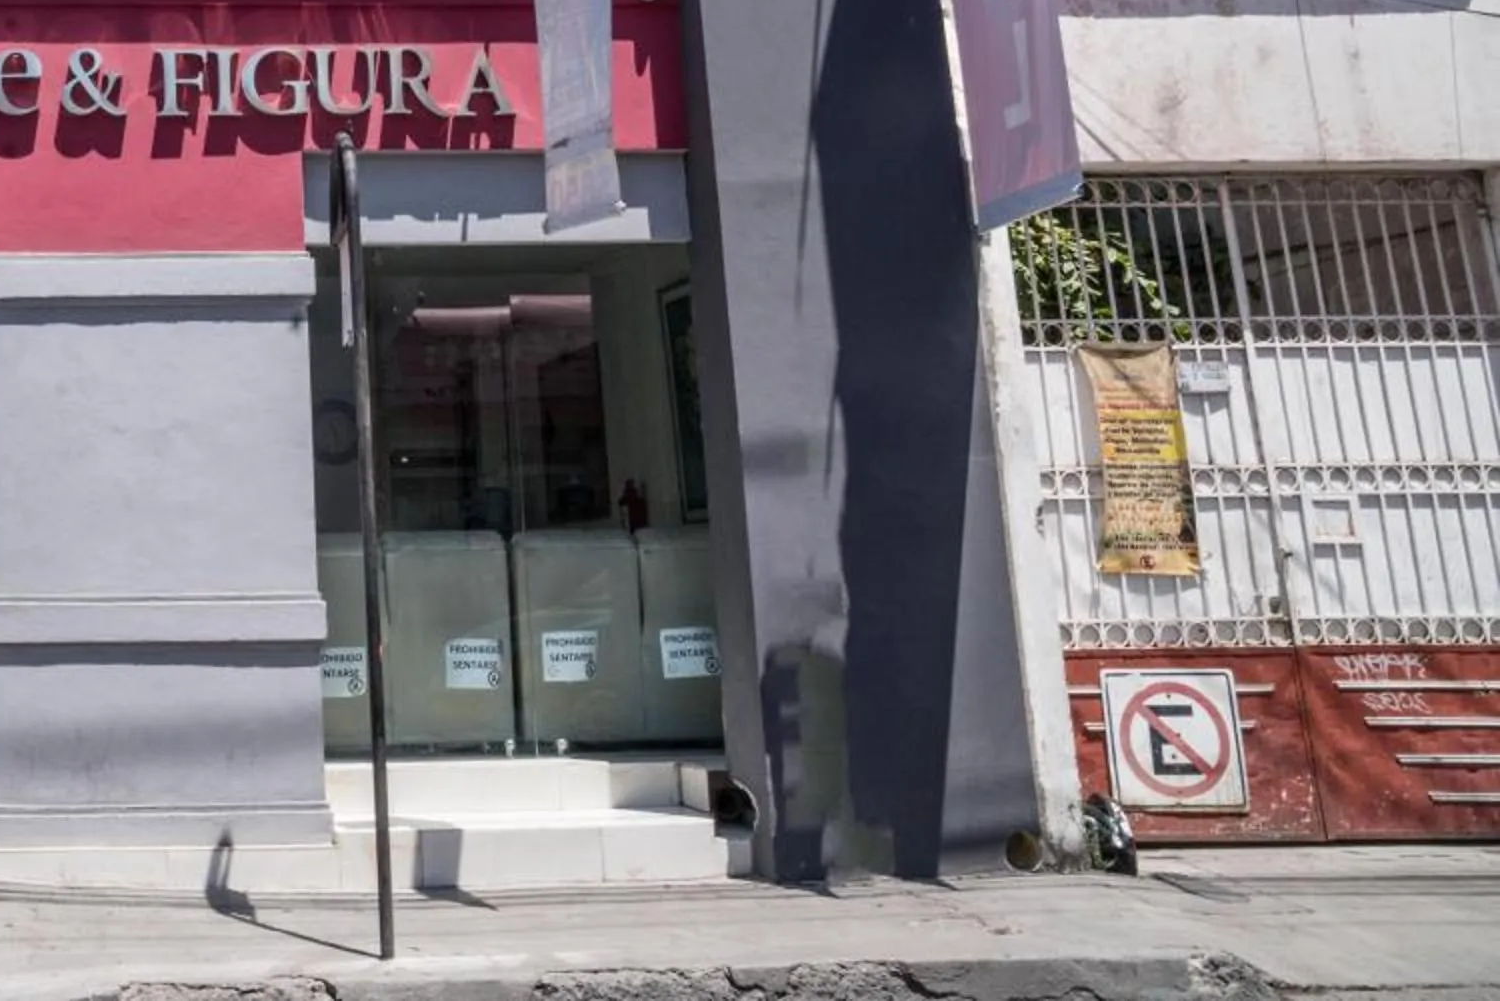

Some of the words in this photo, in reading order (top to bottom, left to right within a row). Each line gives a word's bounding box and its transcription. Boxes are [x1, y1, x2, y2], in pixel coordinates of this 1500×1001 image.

[61, 47, 127, 117] &
[155, 45, 517, 117] FIGURA
[322, 653, 363, 663] OHIBIDO
